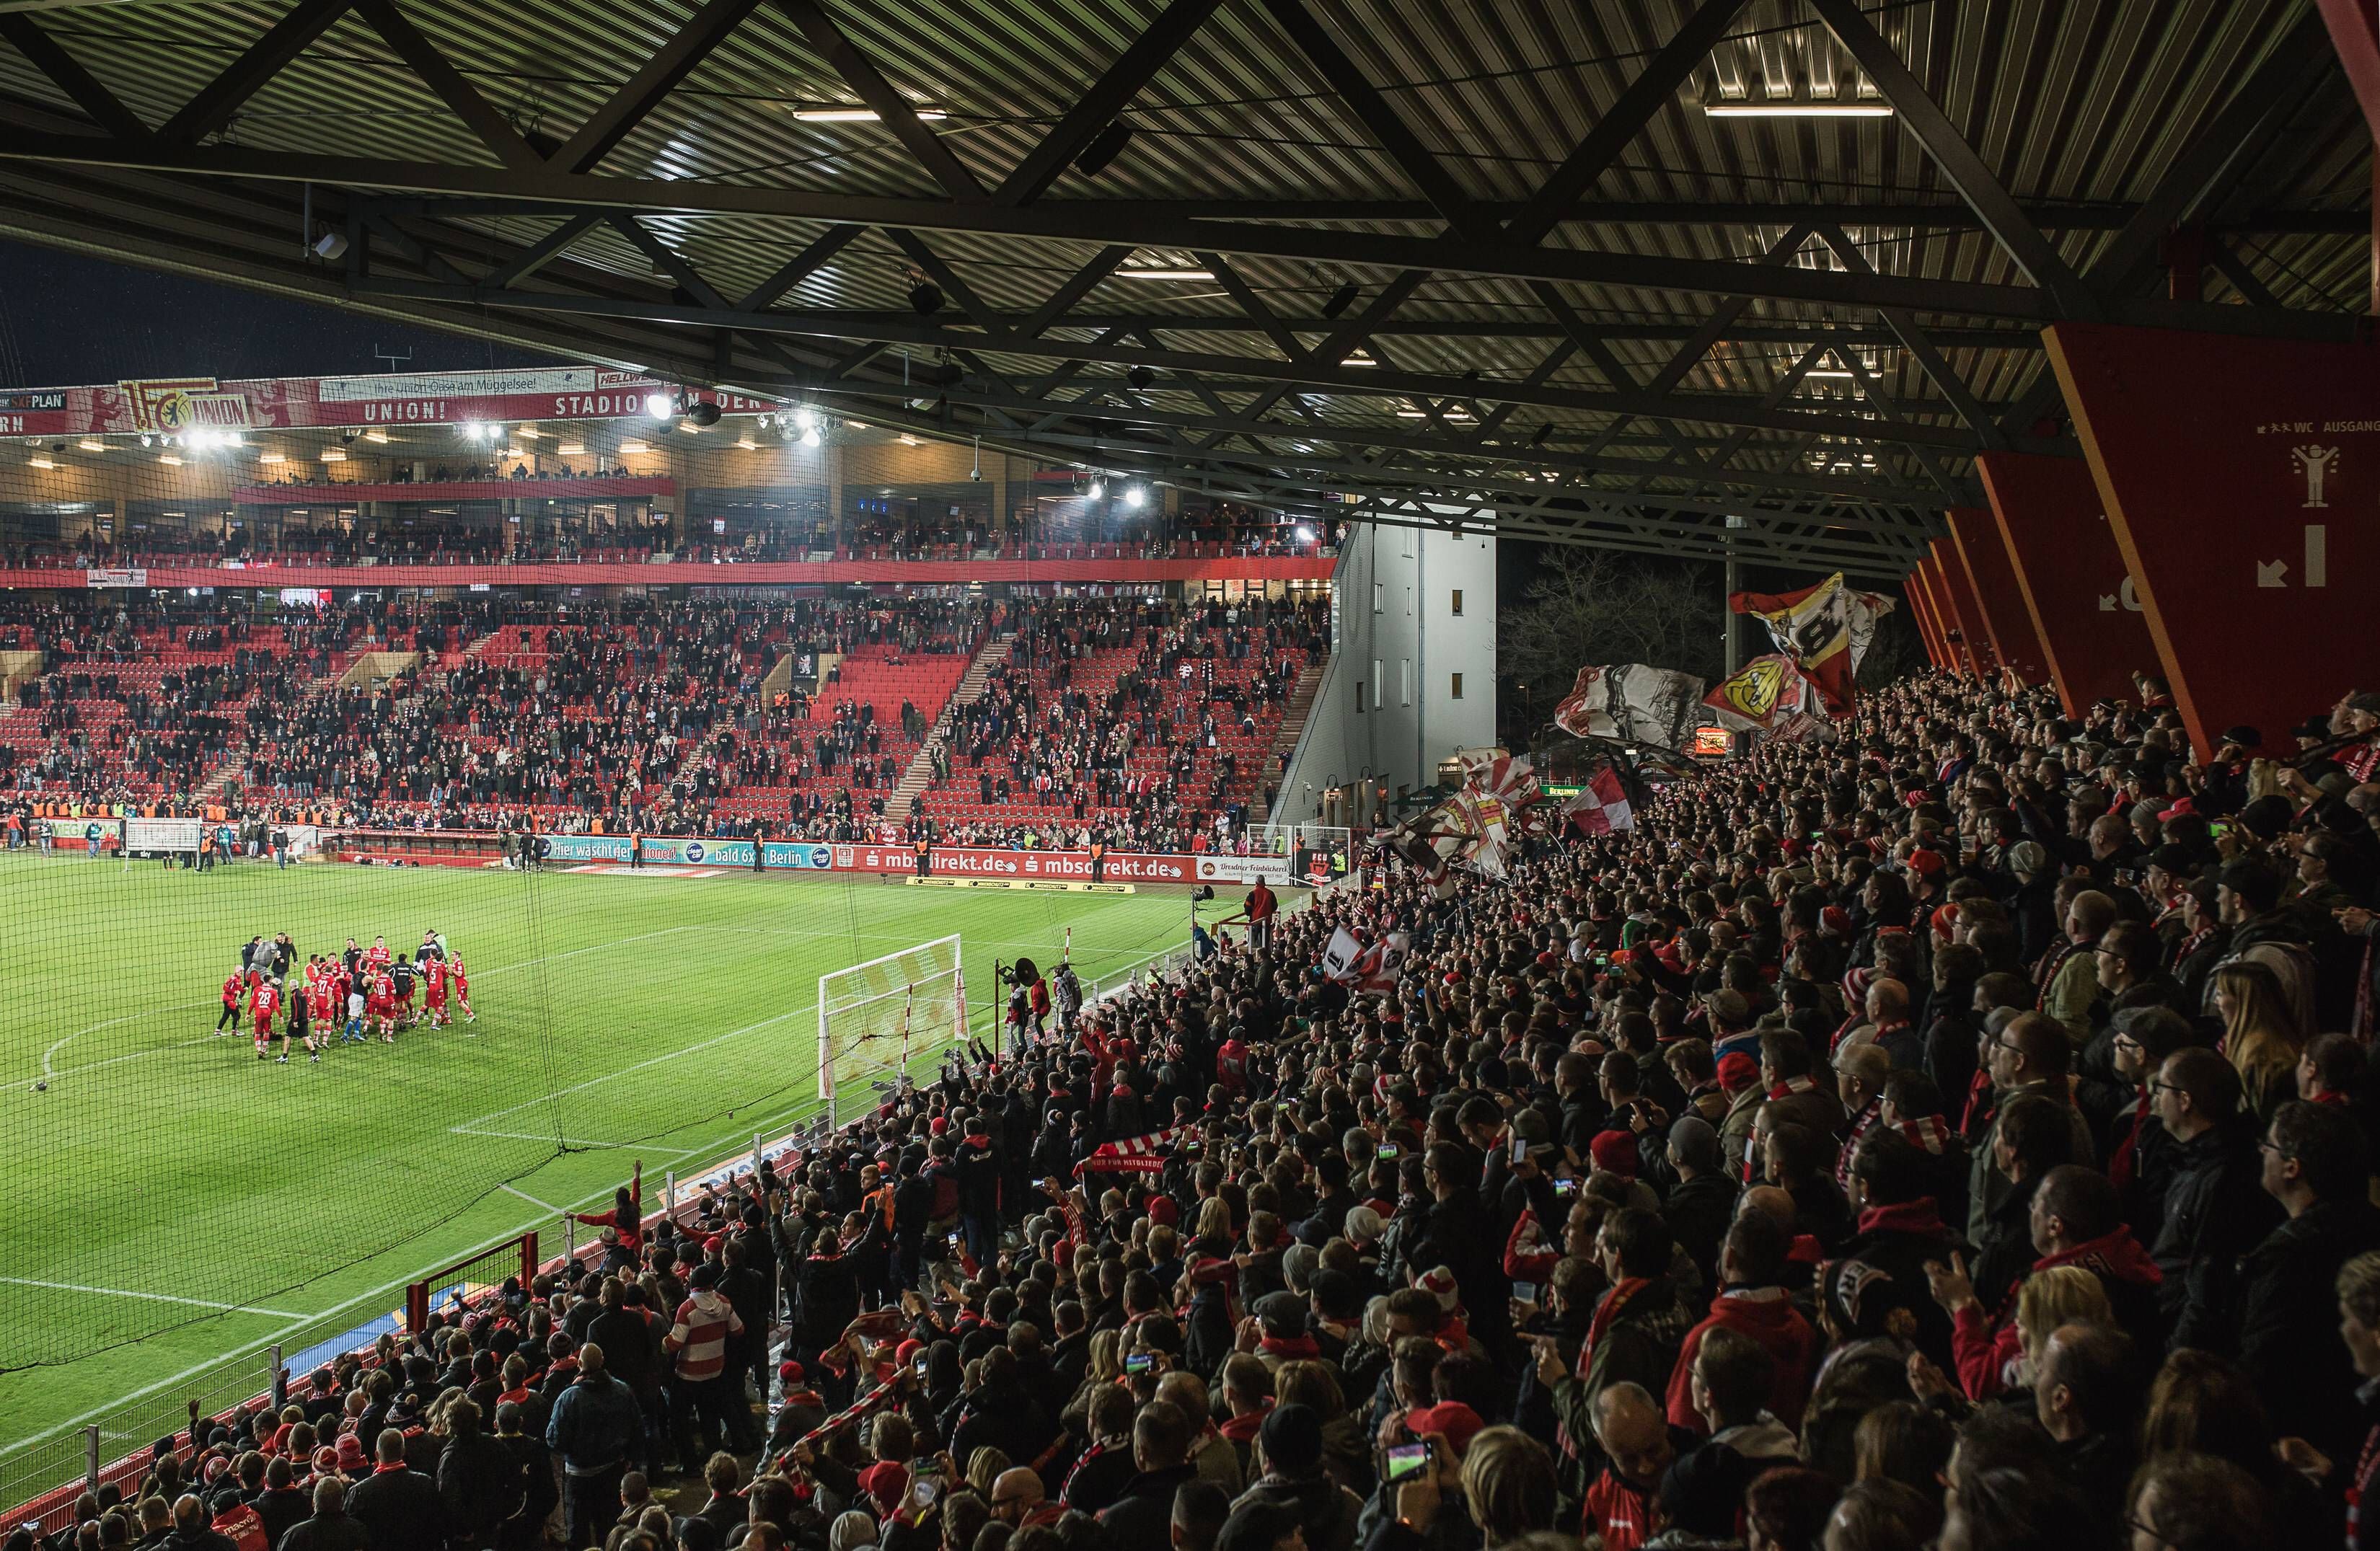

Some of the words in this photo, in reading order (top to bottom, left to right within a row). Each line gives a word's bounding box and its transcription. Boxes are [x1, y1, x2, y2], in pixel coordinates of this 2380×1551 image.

[375, 383, 394, 393] Ihre
[397, 380, 454, 392] Union-Oase
[459, 382, 473, 391] am
[477, 377, 536, 392] Müggelsee!
[192, 399, 245, 425] UNION
[365, 401, 445, 421] UNION!
[2293, 422, 2314, 433] WC
[2323, 420, 2380, 433] AUSGANG
[555, 842, 574, 856] Hier
[577, 844, 612, 857] wäscht
[614, 844, 631, 857] der
[641, 845, 676, 860] nioner!
[715, 849, 738, 862] bald
[741, 852, 754, 862] 6x
[770, 851, 801, 865] Berlin
[1046, 857, 1168, 877] mbsdrekt.de
[431, 968, 436, 978] 5
[317, 980, 327, 994] 37
[376, 984, 387, 996] 10
[258, 991, 270, 1004] 28
